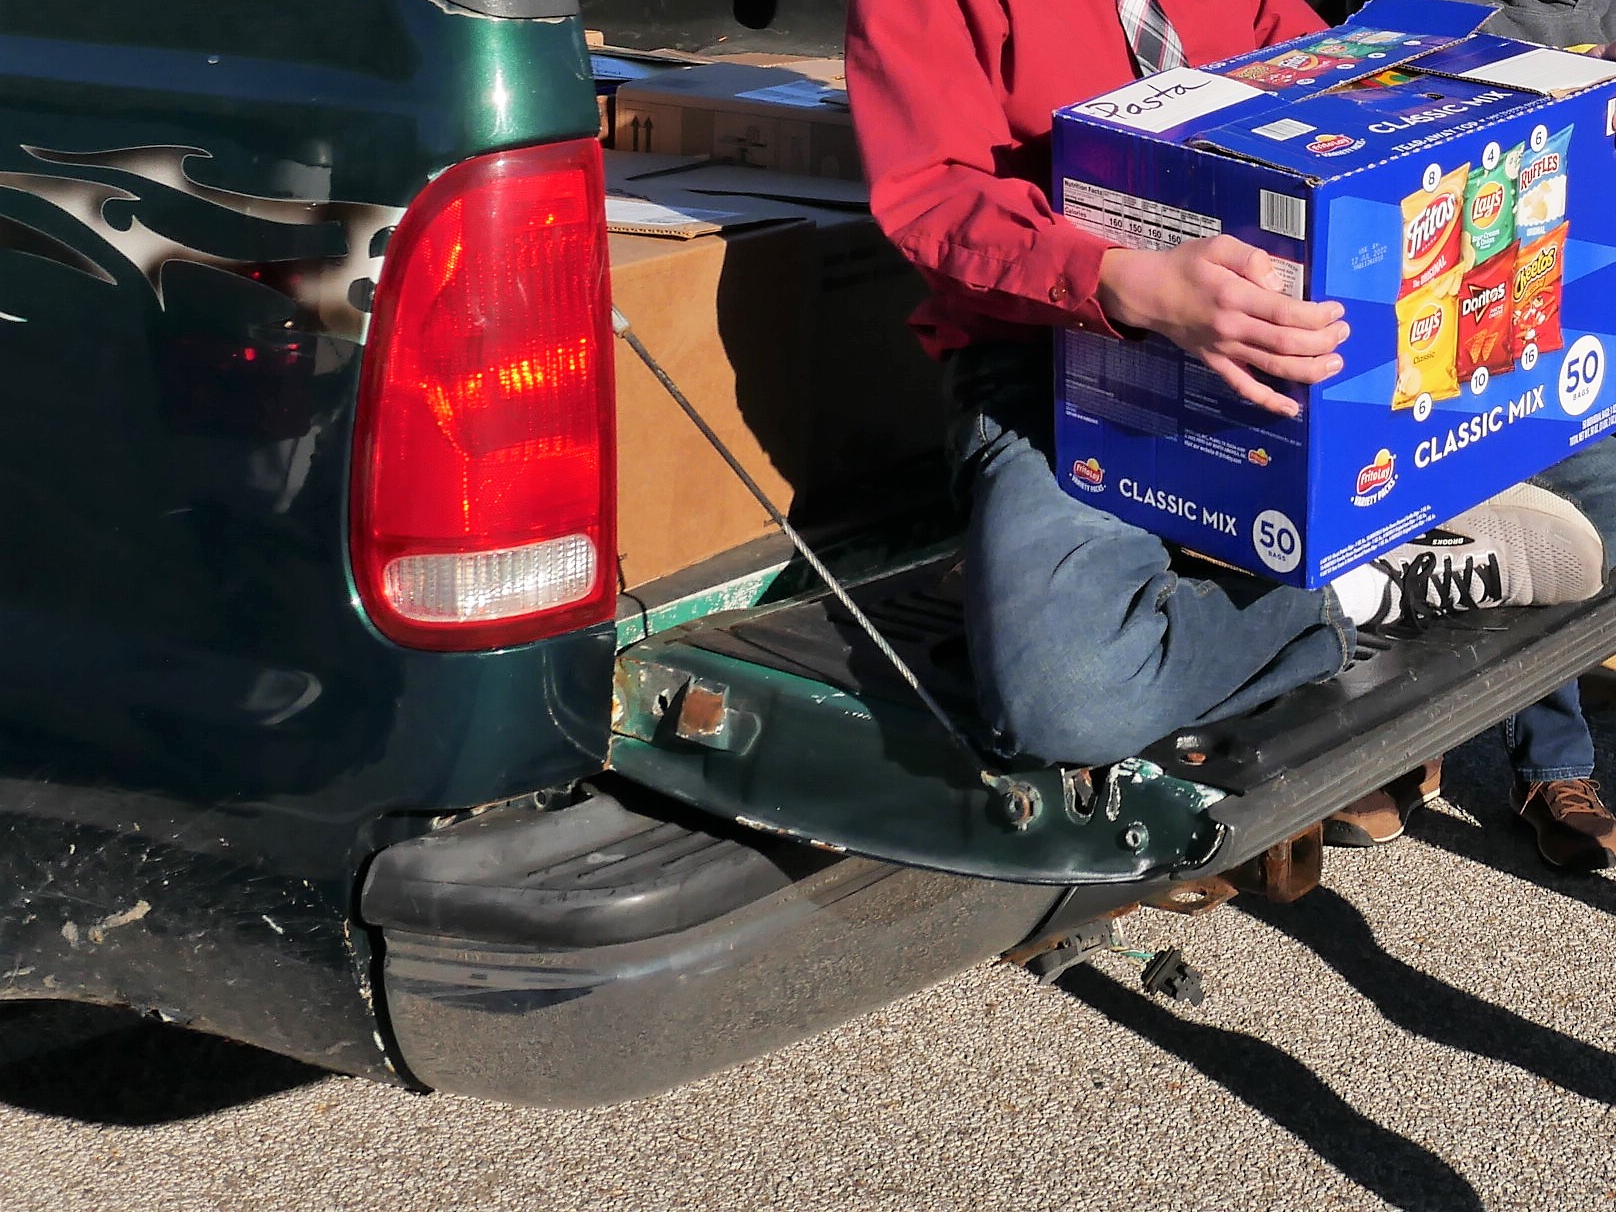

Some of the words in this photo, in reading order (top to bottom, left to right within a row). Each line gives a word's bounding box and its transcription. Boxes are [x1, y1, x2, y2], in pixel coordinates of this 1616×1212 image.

[1084, 80, 1212, 120] Pasta
[1368, 103, 1469, 134] CLASSIC
[1461, 90, 1514, 109] MIX
[1454, 121, 1480, 136] TOP
[1535, 134, 1543, 146] 6
[1487, 150, 1495, 164] 4
[1428, 171, 1436, 186] 8
[1520, 154, 1559, 191] RUFFLES
[1064, 180, 1088, 192] Nutrition
[1087, 186, 1103, 196] Facts
[1064, 207, 1087, 219] Calories
[1109, 217, 1123, 228] 160
[1129, 223, 1143, 234] 150
[1148, 229, 1162, 239] 160
[1168, 234, 1181, 245] 160
[1407, 193, 1457, 260] Fritos
[1513, 247, 1556, 301] Cheetos
[1462, 283, 1506, 316] Doritos
[1413, 351, 1436, 365] Classic
[1524, 349, 1535, 364] 16
[1474, 372, 1486, 388] 10
[1566, 350, 1599, 394] 50
[1572, 388, 1590, 401] BAGS
[1418, 401, 1426, 415] 6
[1414, 406, 1504, 469] CLASSIC
[1508, 385, 1545, 424] MIX
[1354, 493, 1378, 507] VARIETY
[1377, 477, 1397, 505] PACKS
[1119, 478, 1197, 521] CLASSIC
[1202, 506, 1238, 537] MIX
[1259, 520, 1296, 556] 50
[1432, 538, 1464, 546] BROOKS
[1267, 550, 1287, 562] BAGS
